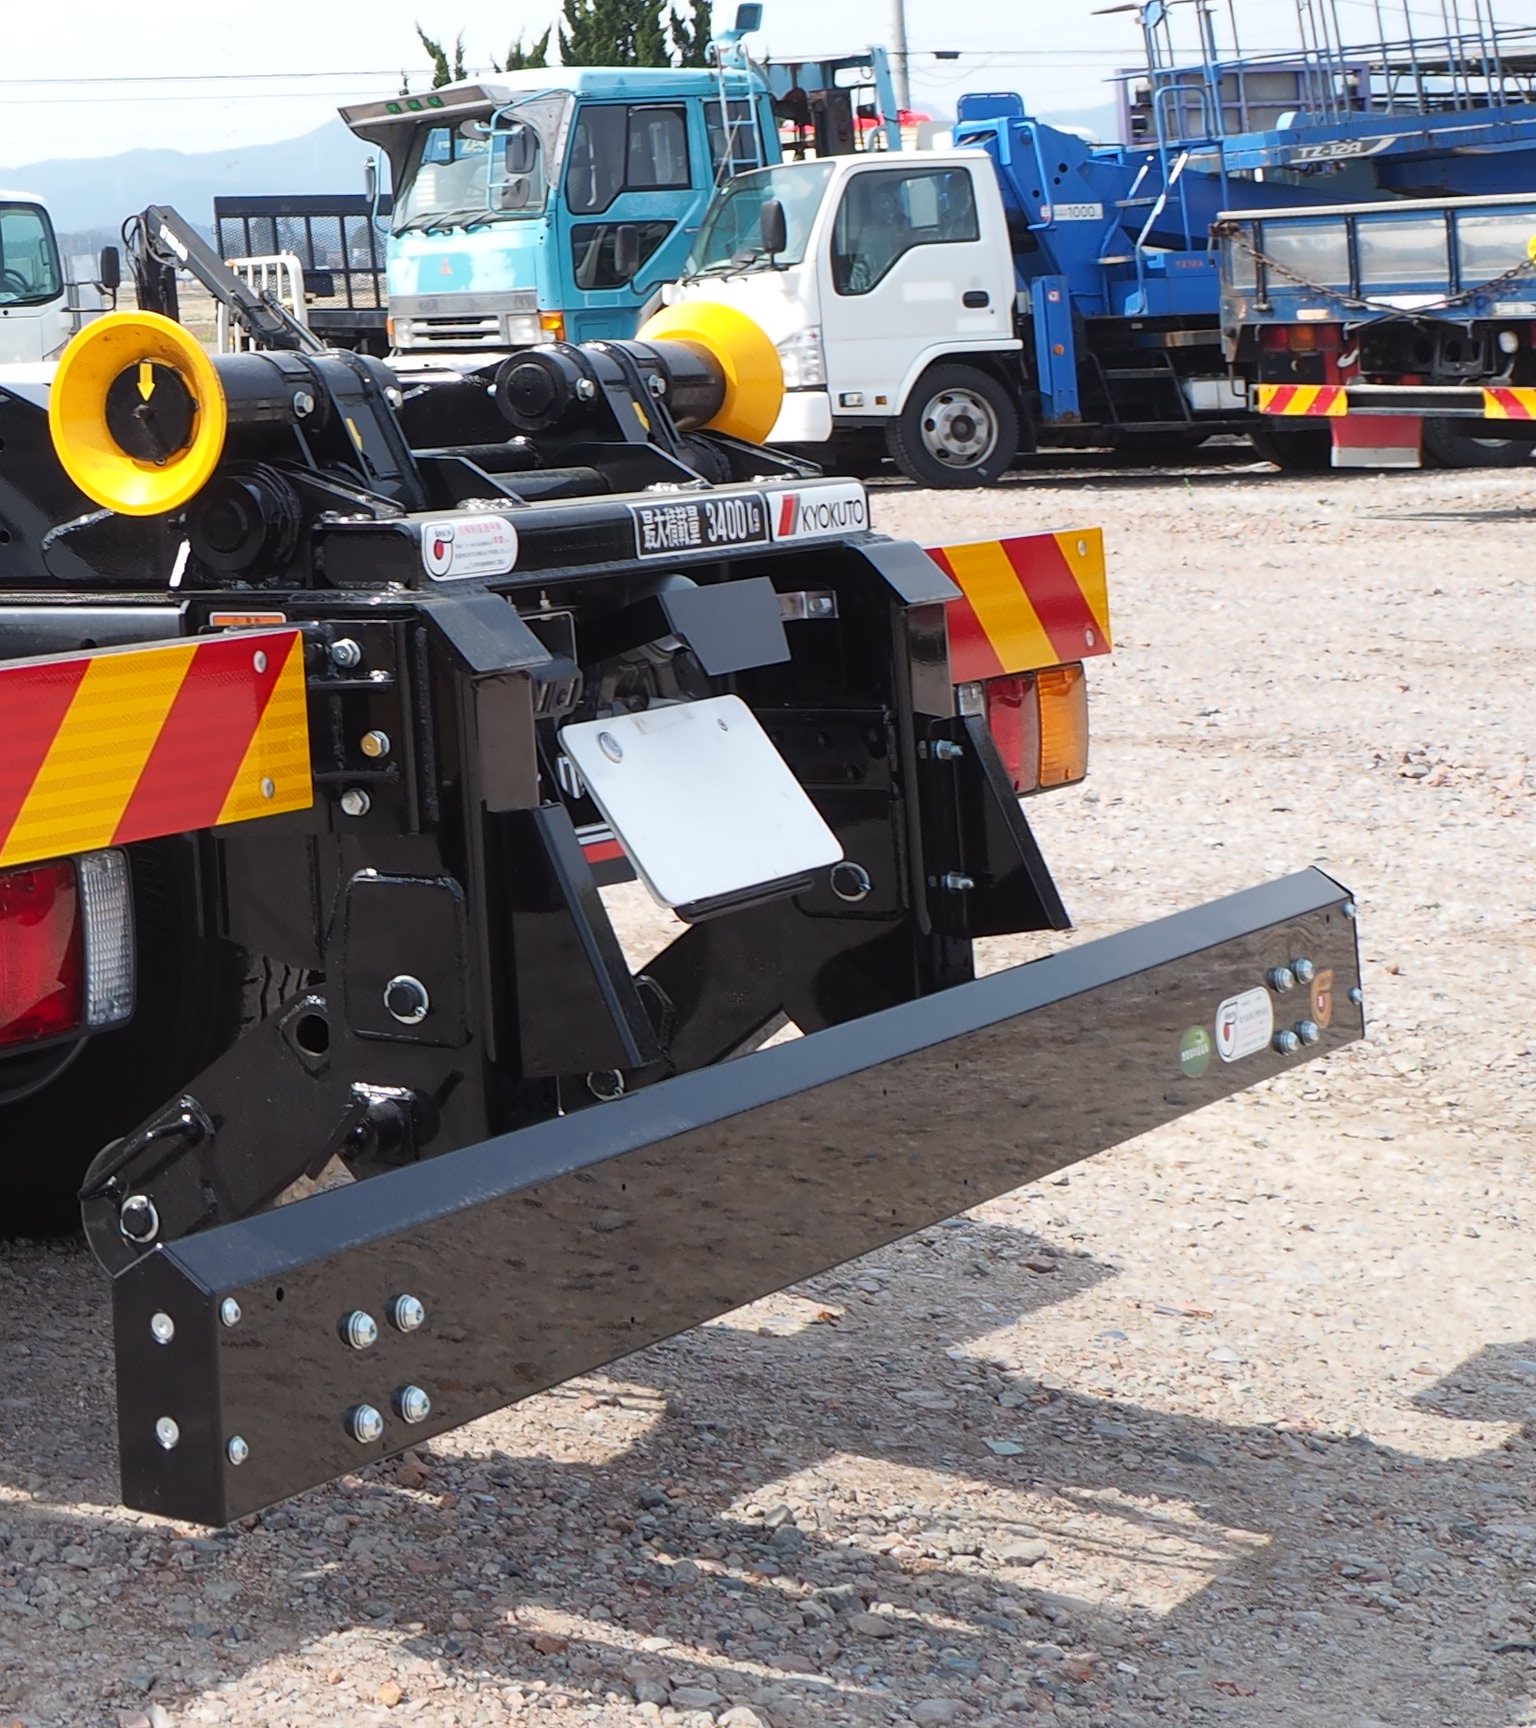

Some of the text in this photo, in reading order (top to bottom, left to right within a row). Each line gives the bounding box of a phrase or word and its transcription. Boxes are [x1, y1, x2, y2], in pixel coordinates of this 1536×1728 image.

[1298, 142, 1362, 158] TZ-12A
[1067, 205, 1095, 218] 1000
[640, 505, 702, 550] 最大積載量
[802, 499, 865, 533] KYOKUTO
